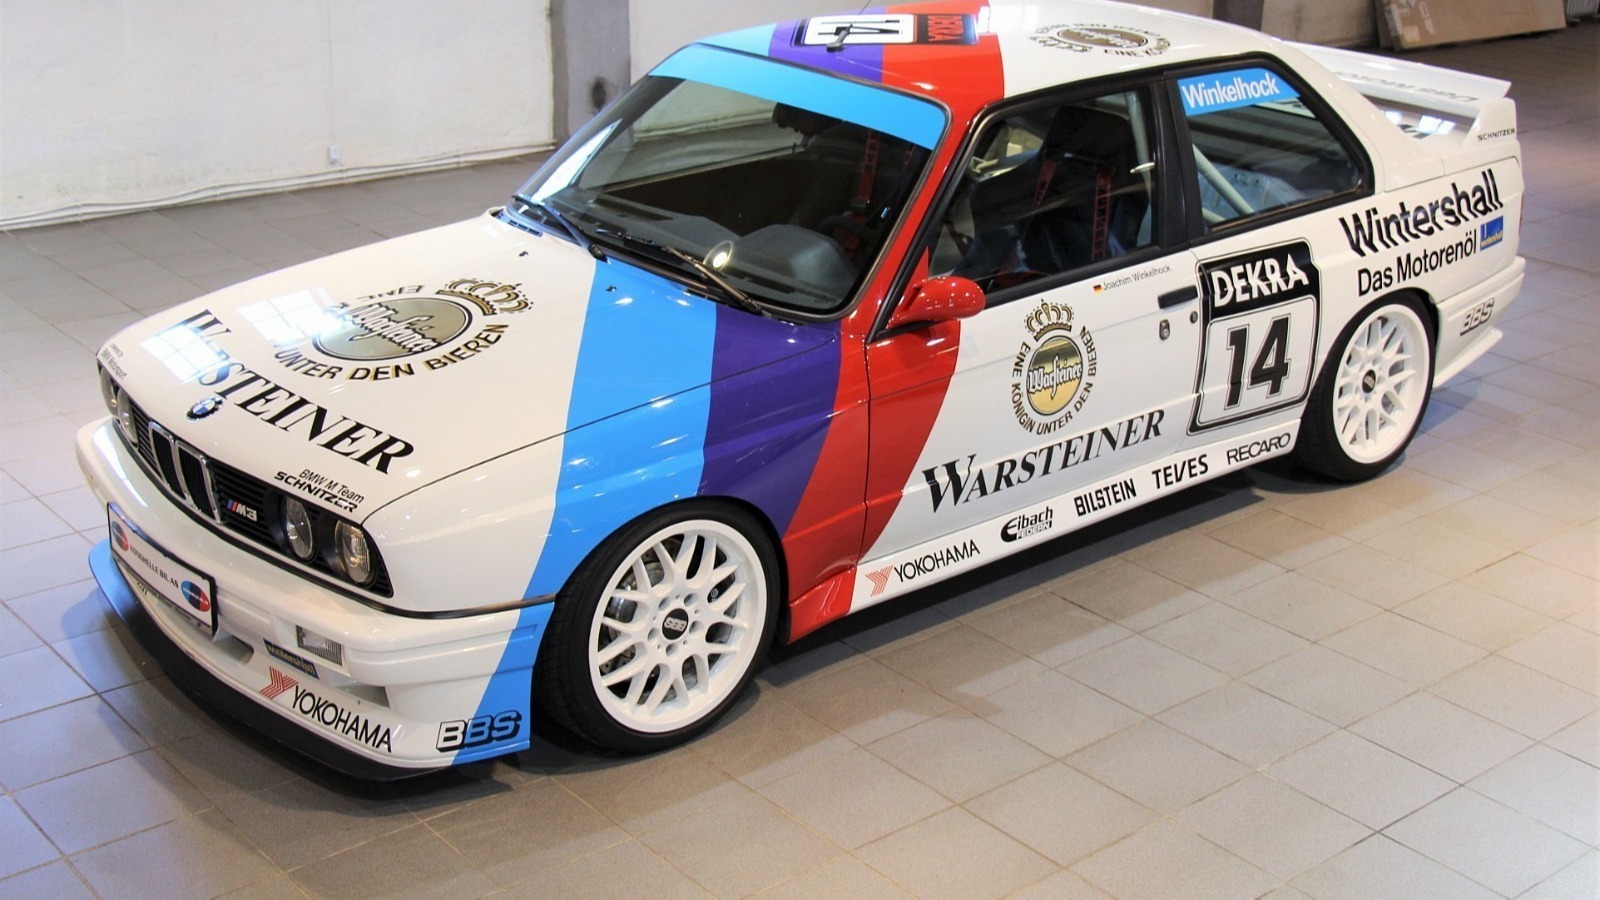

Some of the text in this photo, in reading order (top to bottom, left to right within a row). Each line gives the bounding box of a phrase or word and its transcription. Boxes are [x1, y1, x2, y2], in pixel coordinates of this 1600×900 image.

[928, 15, 963, 42] DEKRA
[1181, 72, 1280, 108] Winkelhock
[1477, 127, 1516, 142] SCHNITZER
[1338, 168, 1504, 257] Wintershall
[1103, 264, 1171, 291] Joachim Winkelhock
[1211, 253, 1310, 308] DEKRA
[1357, 229, 1477, 297] Das Motorenöl
[1459, 297, 1495, 336] BBS
[274, 323, 510, 381] UNTER DEN BIEREN
[1223, 312, 1292, 411] 14
[1011, 325, 1097, 435] EINE KÖNIGIN UNTER DEN BIEREN
[922, 409, 1165, 514] WARSTEINER
[1226, 432, 1291, 466] RECARO
[299, 468, 365, 504] BMW M Team
[1152, 454, 1209, 490] TEVES
[274, 471, 358, 513] SCHNITZER
[1073, 479, 1138, 517] BILSTEIN
[236, 503, 258, 522] M3
[1000, 505, 1053, 543] Eibach
[894, 539, 980, 584] YOKOHAMA
[170, 578, 179, 589] AS
[664, 617, 688, 632] BBS
[292, 685, 392, 753] YOKOHAMA
[435, 710, 522, 753] BBS
